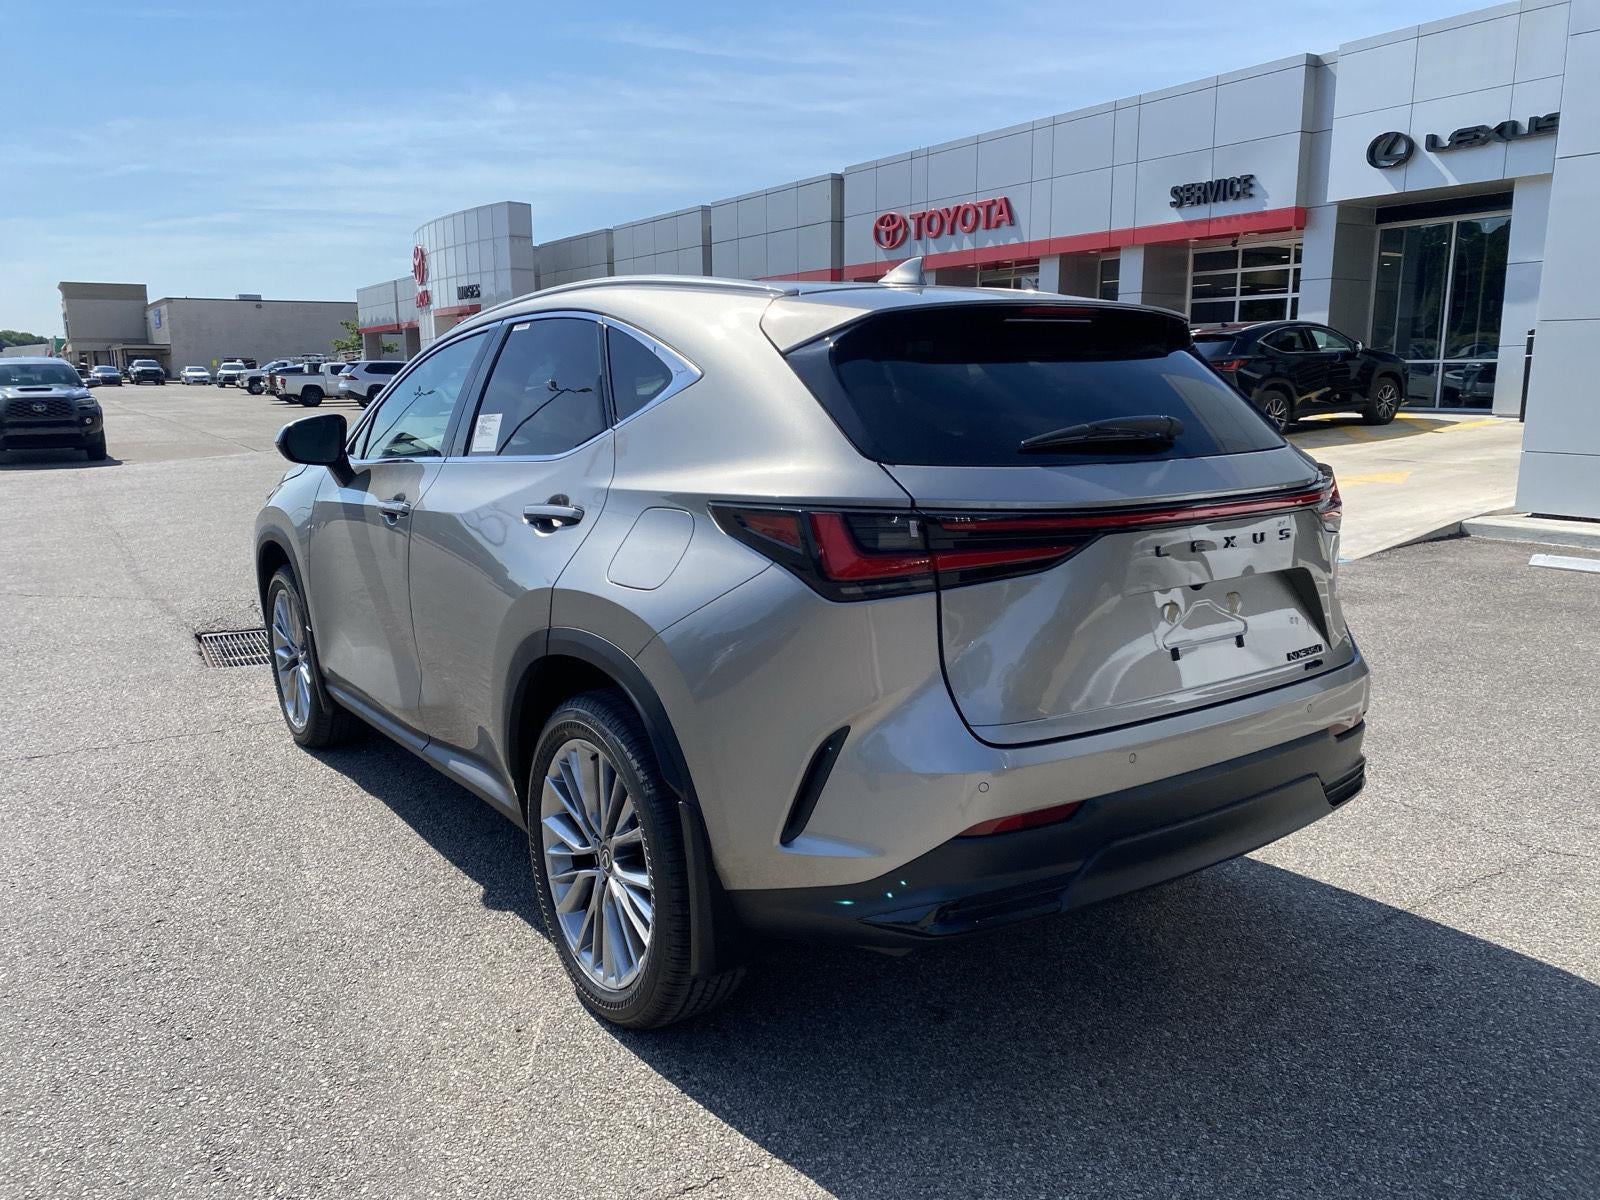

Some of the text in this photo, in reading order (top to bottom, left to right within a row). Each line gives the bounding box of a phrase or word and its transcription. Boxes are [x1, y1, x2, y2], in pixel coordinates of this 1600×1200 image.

[1425, 111, 1560, 152] LEXUS
[1169, 174, 1255, 208] SERVICE
[909, 196, 1015, 241] TOYOTA
[1154, 528, 1292, 558] LEXUS
